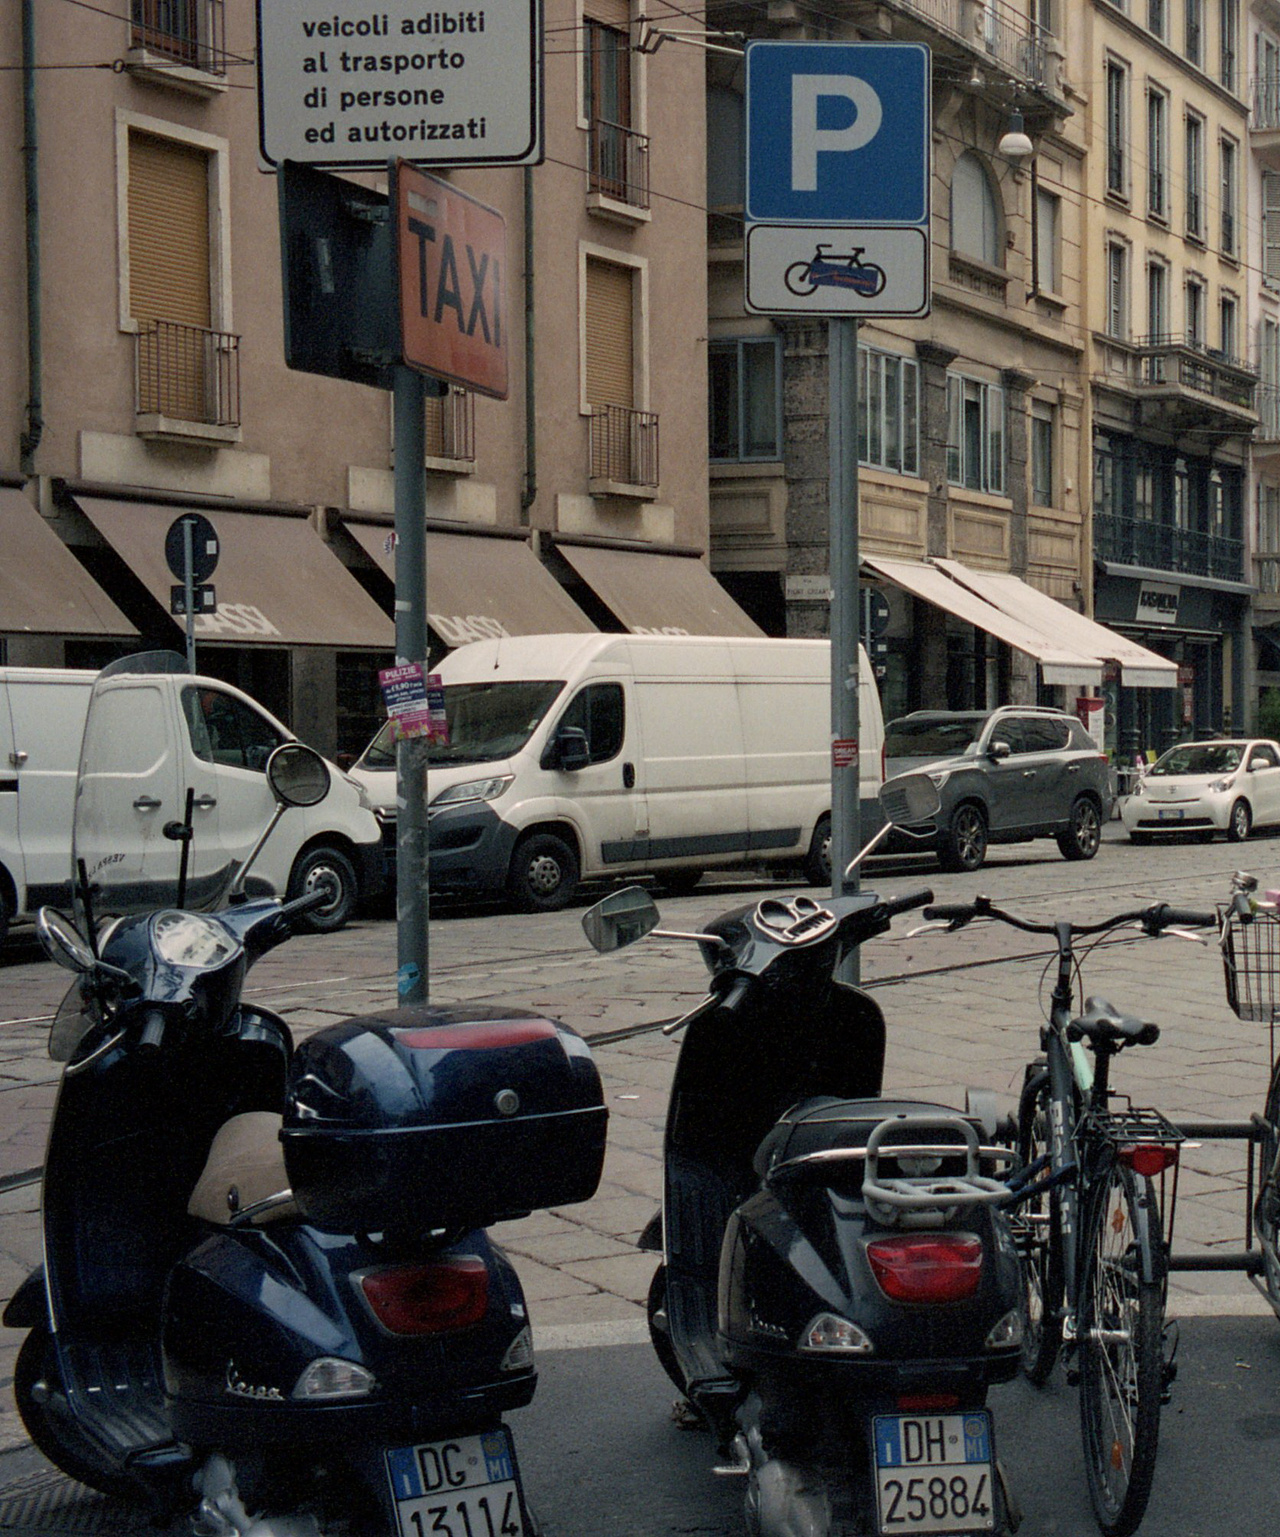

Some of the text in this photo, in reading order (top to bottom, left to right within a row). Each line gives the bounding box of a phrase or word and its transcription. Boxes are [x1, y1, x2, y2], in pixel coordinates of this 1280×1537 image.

[303, 11, 485, 37] veicoli adibiti
[303, 49, 465, 74] al trasporto
[304, 87, 445, 112] di persone
[305, 117, 486, 143] ed autorizzati
[791, 74, 883, 191] P
[408, 216, 501, 348] TAXI
[385, 666, 416, 680] PULIZIE
[225, 1358, 285, 1401] Vespa
[903, 1420, 946, 1462] DH
[967, 1439, 983, 1458] MI
[417, 1444, 466, 1491] DG
[489, 1458, 509, 1480] MI
[410, 1491, 519, 1537] 13114
[884, 1474, 990, 1523] 25884
